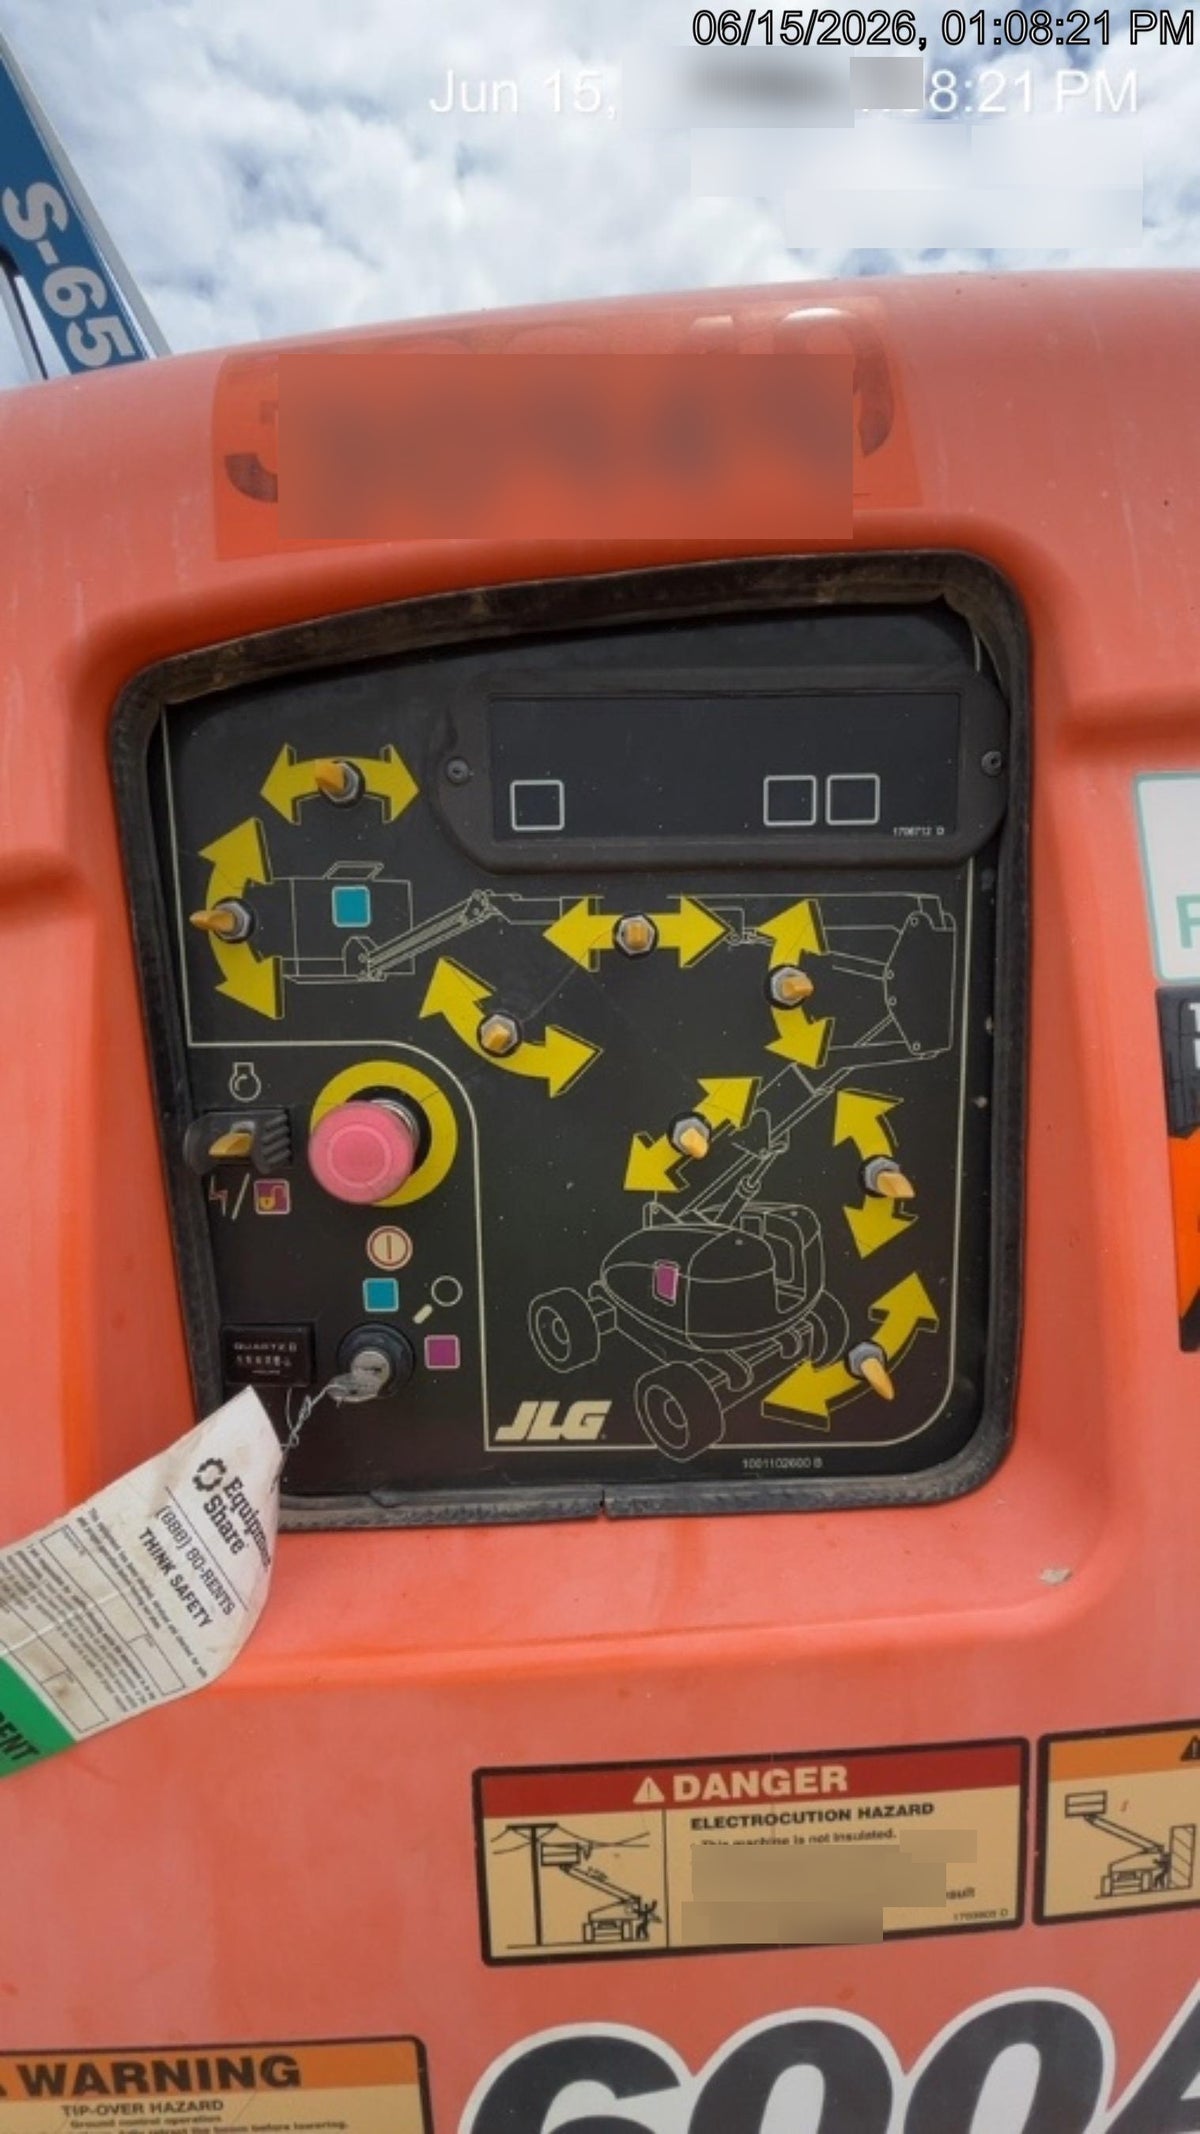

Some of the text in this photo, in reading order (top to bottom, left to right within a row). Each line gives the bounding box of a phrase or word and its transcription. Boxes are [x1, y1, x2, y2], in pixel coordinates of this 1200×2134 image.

[4, 182, 137, 368] S-65
[494, 1401, 612, 1440] JLG
[203, 1494, 246, 1555] Share
[139, 1527, 213, 1628] THINK SAFETY
[673, 1765, 848, 1803] DANGER
[691, 1802, 935, 1831] ELECTROCUTION HAZARD
[16, 2055, 302, 2098] WARNING
[62, 2100, 224, 2117] TIP-OVER HAZARD
